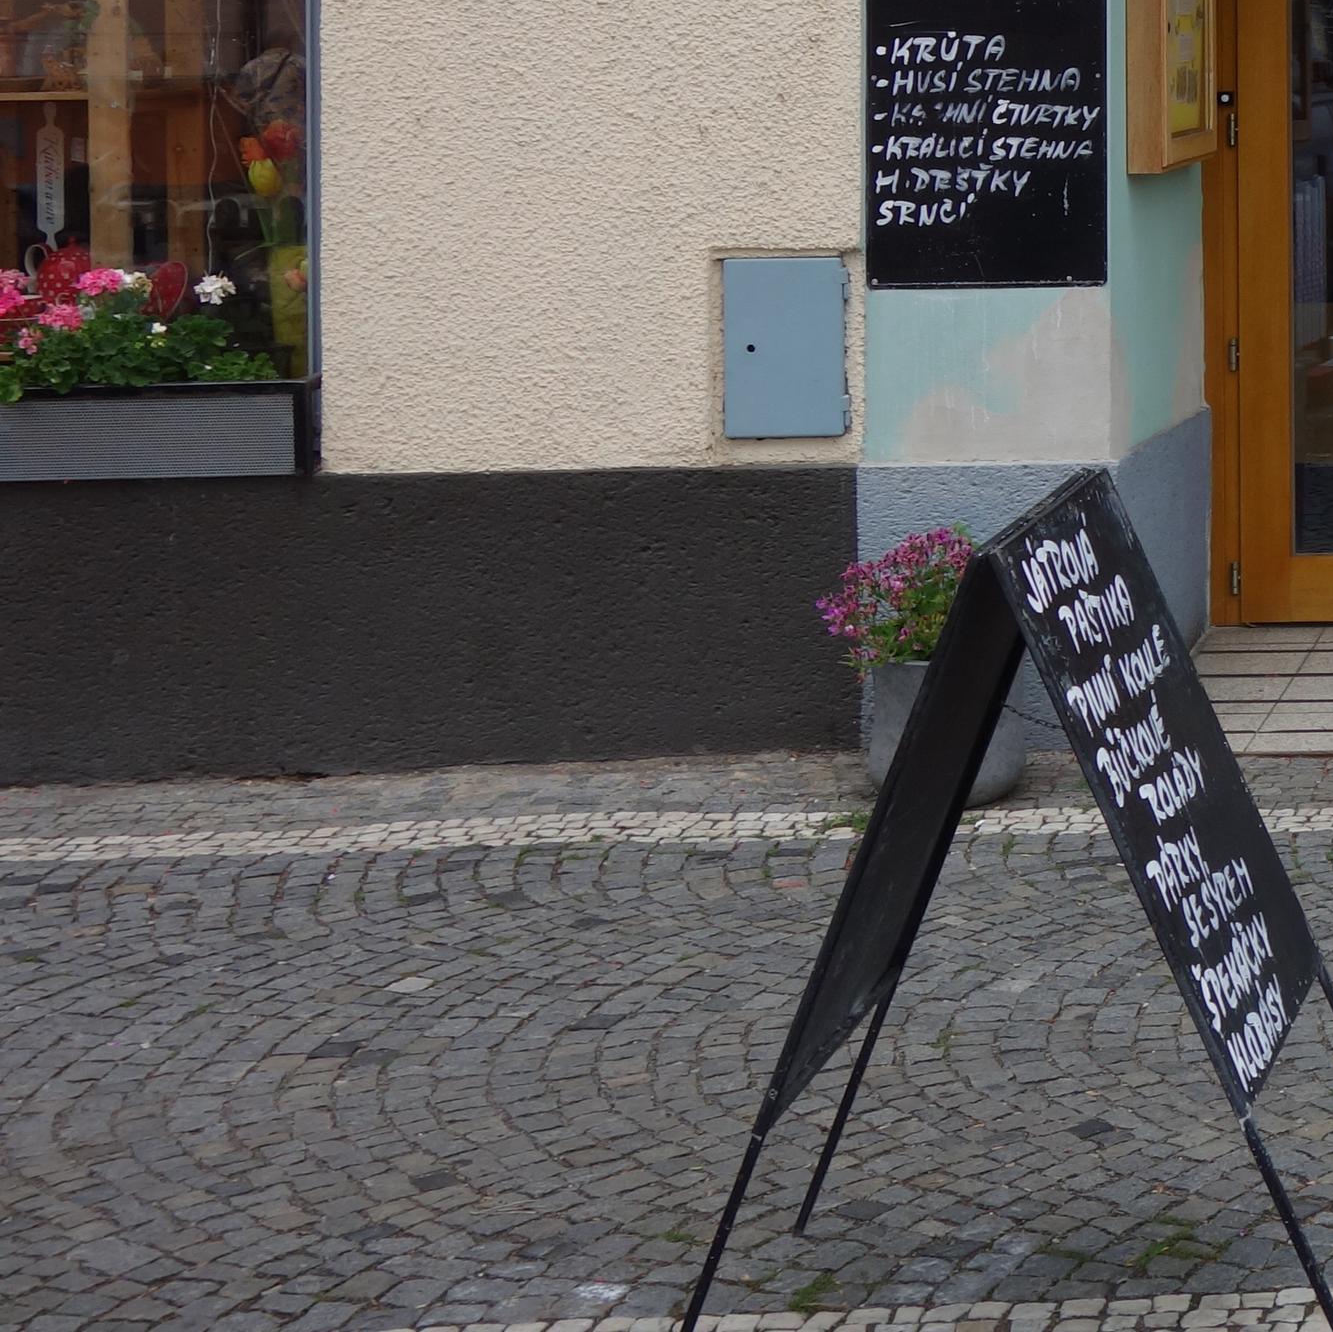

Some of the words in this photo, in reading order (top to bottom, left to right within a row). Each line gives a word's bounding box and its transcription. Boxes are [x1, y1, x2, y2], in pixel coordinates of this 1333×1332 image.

[964, 67, 1081, 93] STEHNA
[992, 99, 1100, 131] ČTVRTKY
[989, 136, 1093, 161] STEHNA
[1022, 512, 1099, 614] JÁTROVÁ
[1058, 574, 1135, 654] PAŠTIKA
[1066, 654, 1120, 738] PIVNÍ
[1118, 624, 1171, 699] KOULE
[1145, 826, 1204, 913] PÁRKY
[1182, 893, 1210, 948] SE
[1227, 973, 1289, 1092] KLOBÁSY
